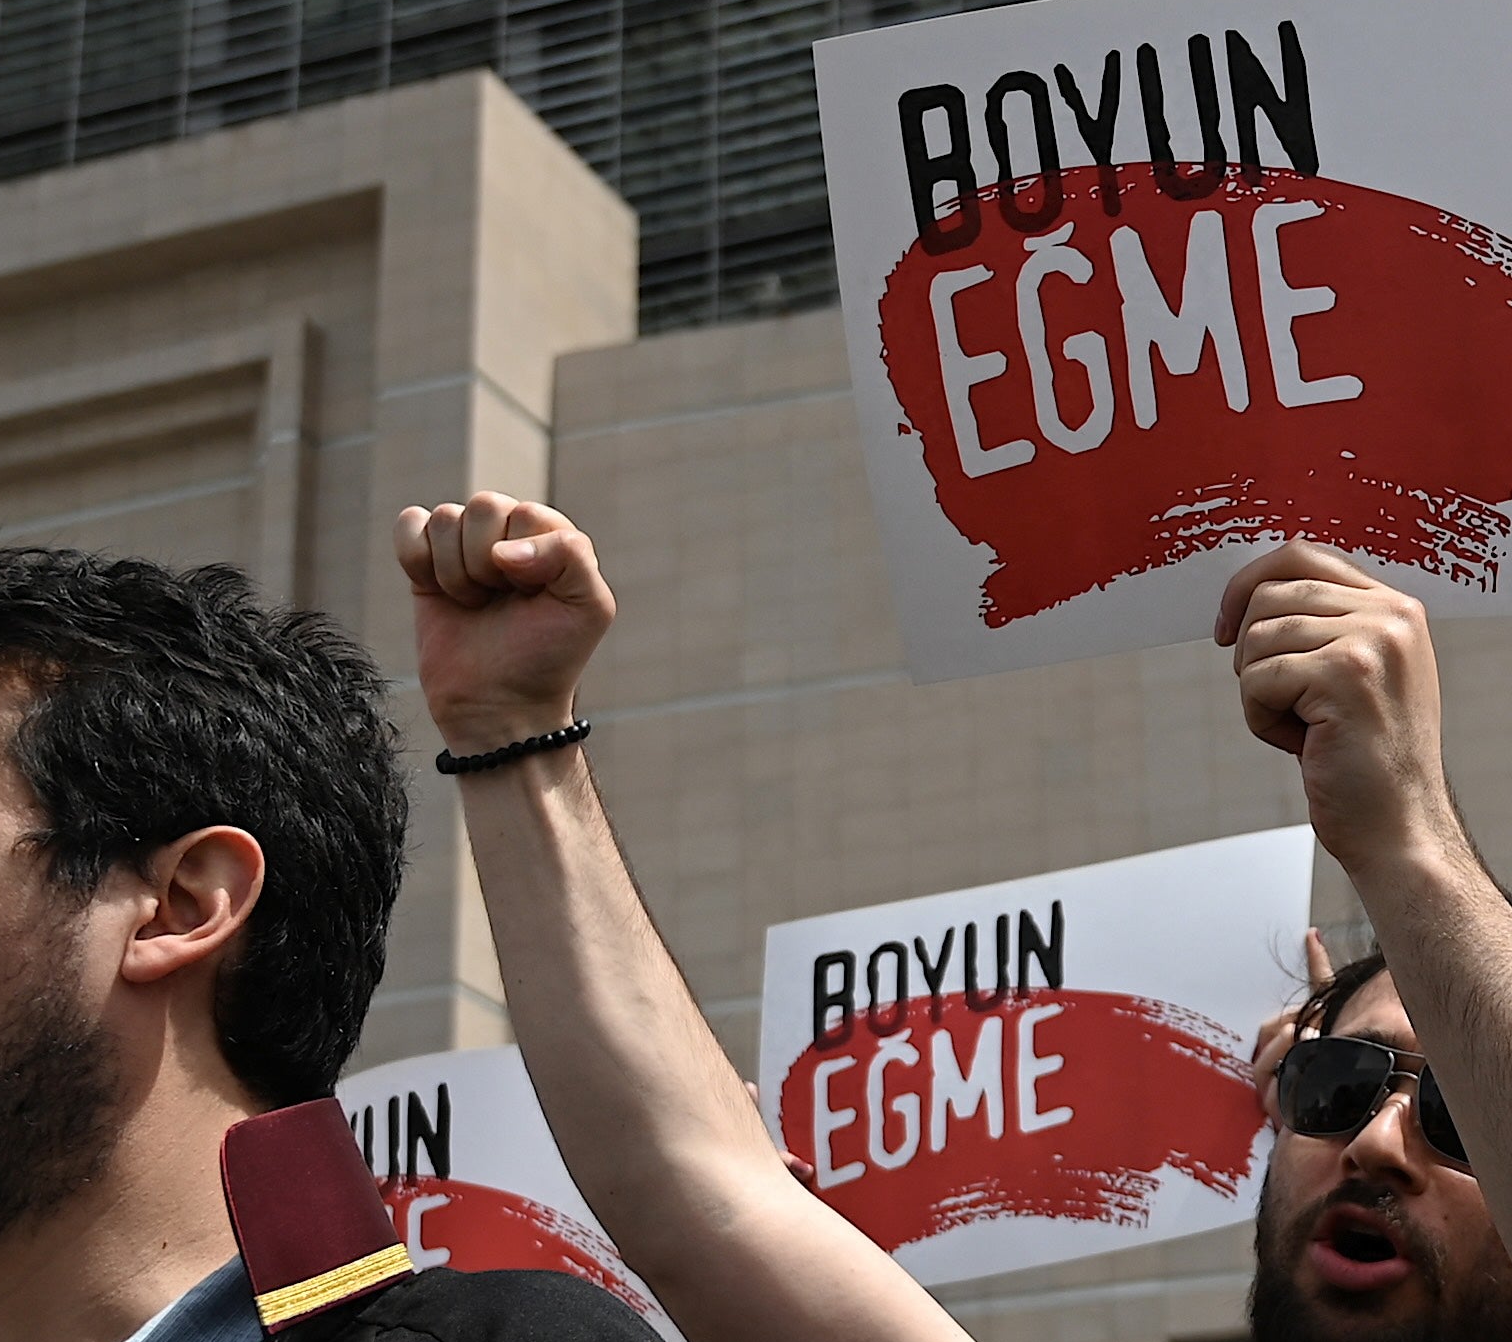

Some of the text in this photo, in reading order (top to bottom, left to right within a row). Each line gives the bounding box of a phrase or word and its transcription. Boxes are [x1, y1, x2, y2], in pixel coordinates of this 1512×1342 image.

[898, 20, 1320, 256] BOYUN
[928, 199, 1364, 479] EĞME
[813, 899, 1065, 1051] BOYUN
[813, 1003, 1074, 1189] EĞME
